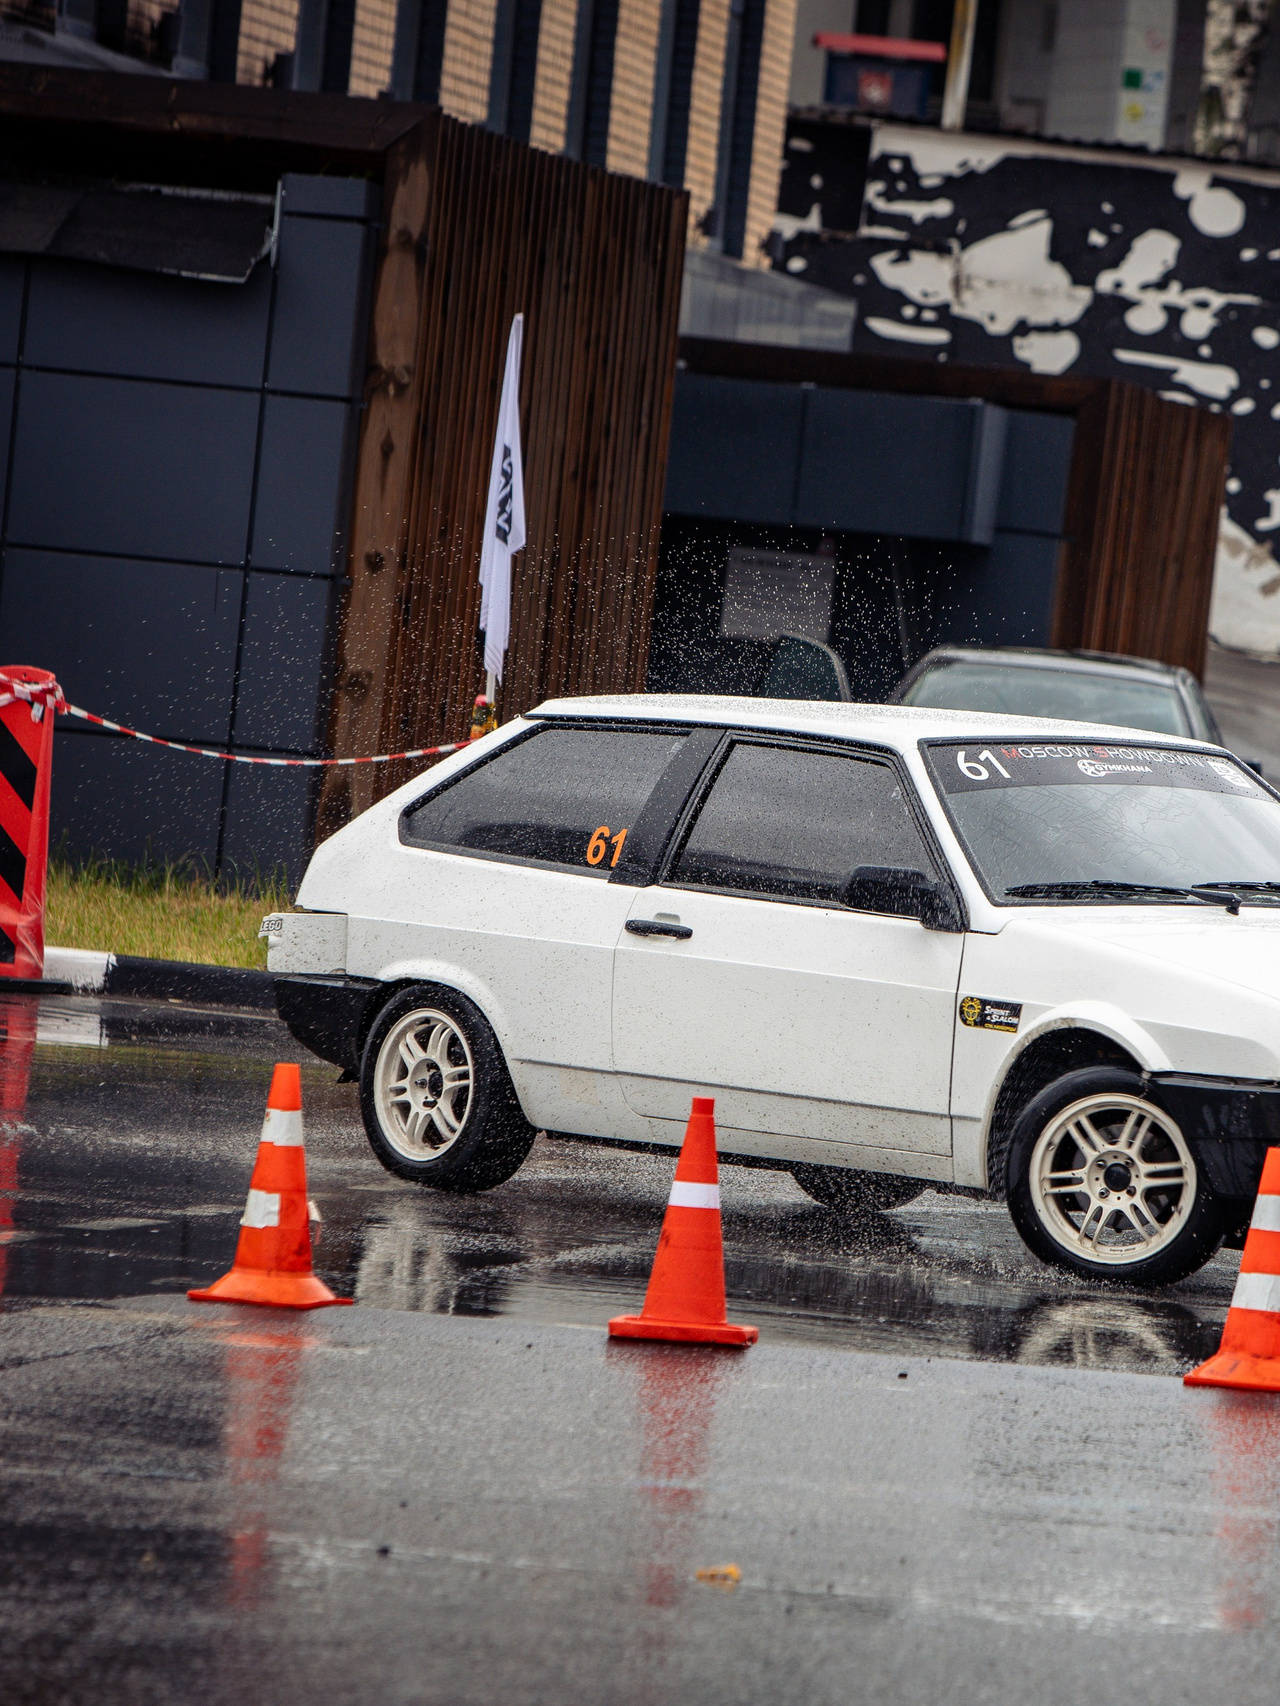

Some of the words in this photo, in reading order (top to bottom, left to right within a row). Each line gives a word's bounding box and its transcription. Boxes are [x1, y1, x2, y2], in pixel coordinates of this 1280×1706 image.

[957, 750, 1012, 780] 61
[1001, 746, 1090, 759] MOSCOW
[1092, 746, 1205, 768] SHOWDOWN
[1095, 764, 1153, 773] GYMKHANA
[586, 825, 628, 867] 61
